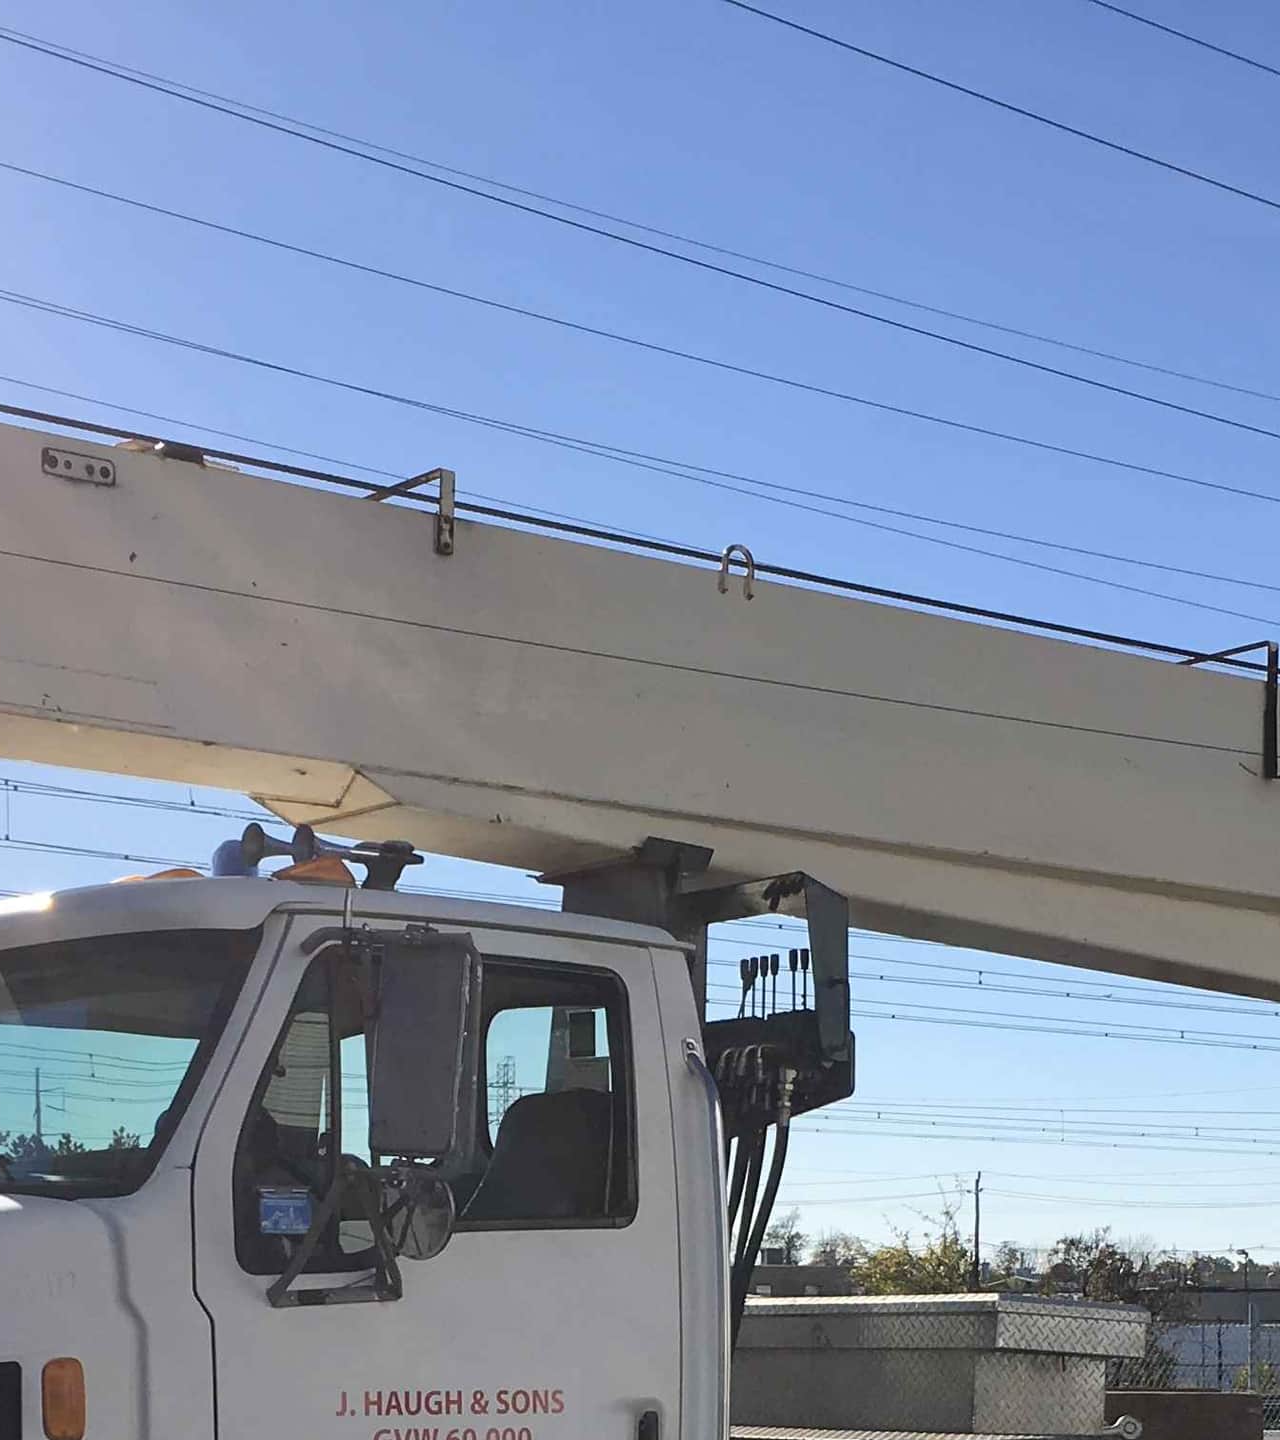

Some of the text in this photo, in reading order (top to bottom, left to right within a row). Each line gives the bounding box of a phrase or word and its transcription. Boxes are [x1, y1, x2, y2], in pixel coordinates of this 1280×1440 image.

[335, 1389, 565, 1417] J. HAUGH & SONS
